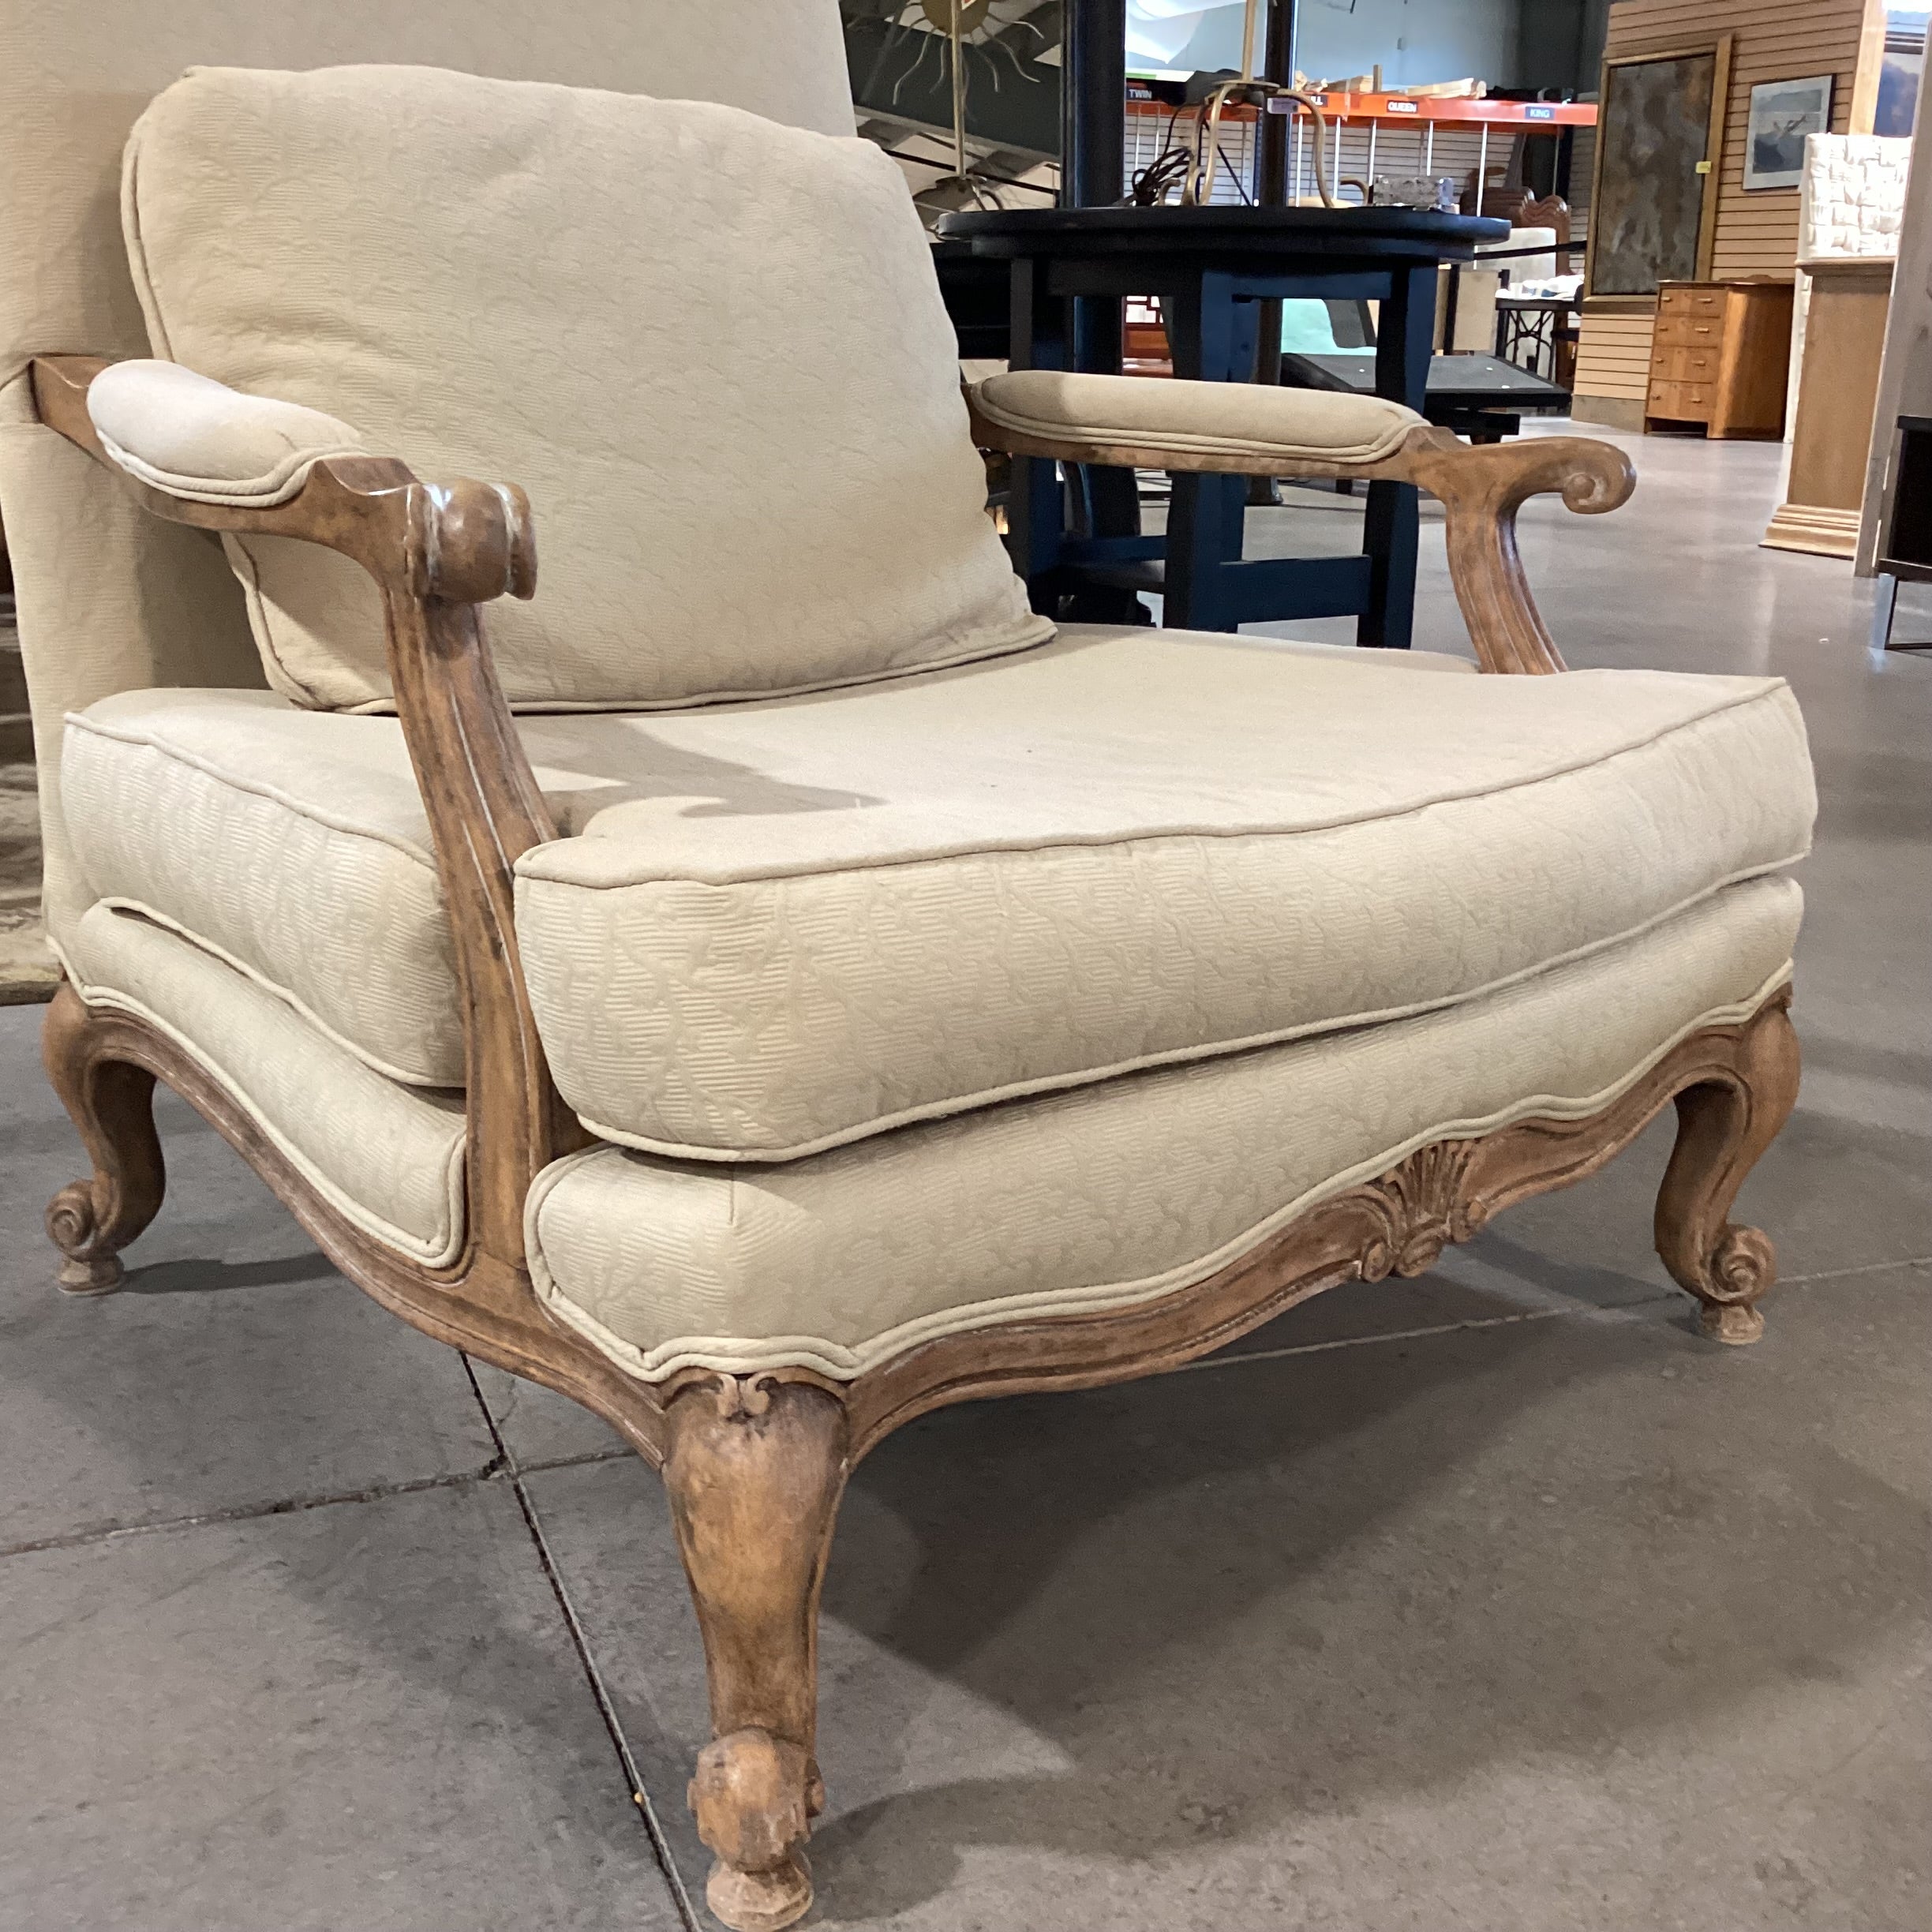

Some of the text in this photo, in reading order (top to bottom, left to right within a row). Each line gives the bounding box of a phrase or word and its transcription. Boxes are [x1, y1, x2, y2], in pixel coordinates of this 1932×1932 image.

[1129, 88, 1152, 99] TWIN
[1387, 101, 1417, 113] QUEEN
[1530, 108, 1551, 118] KING
